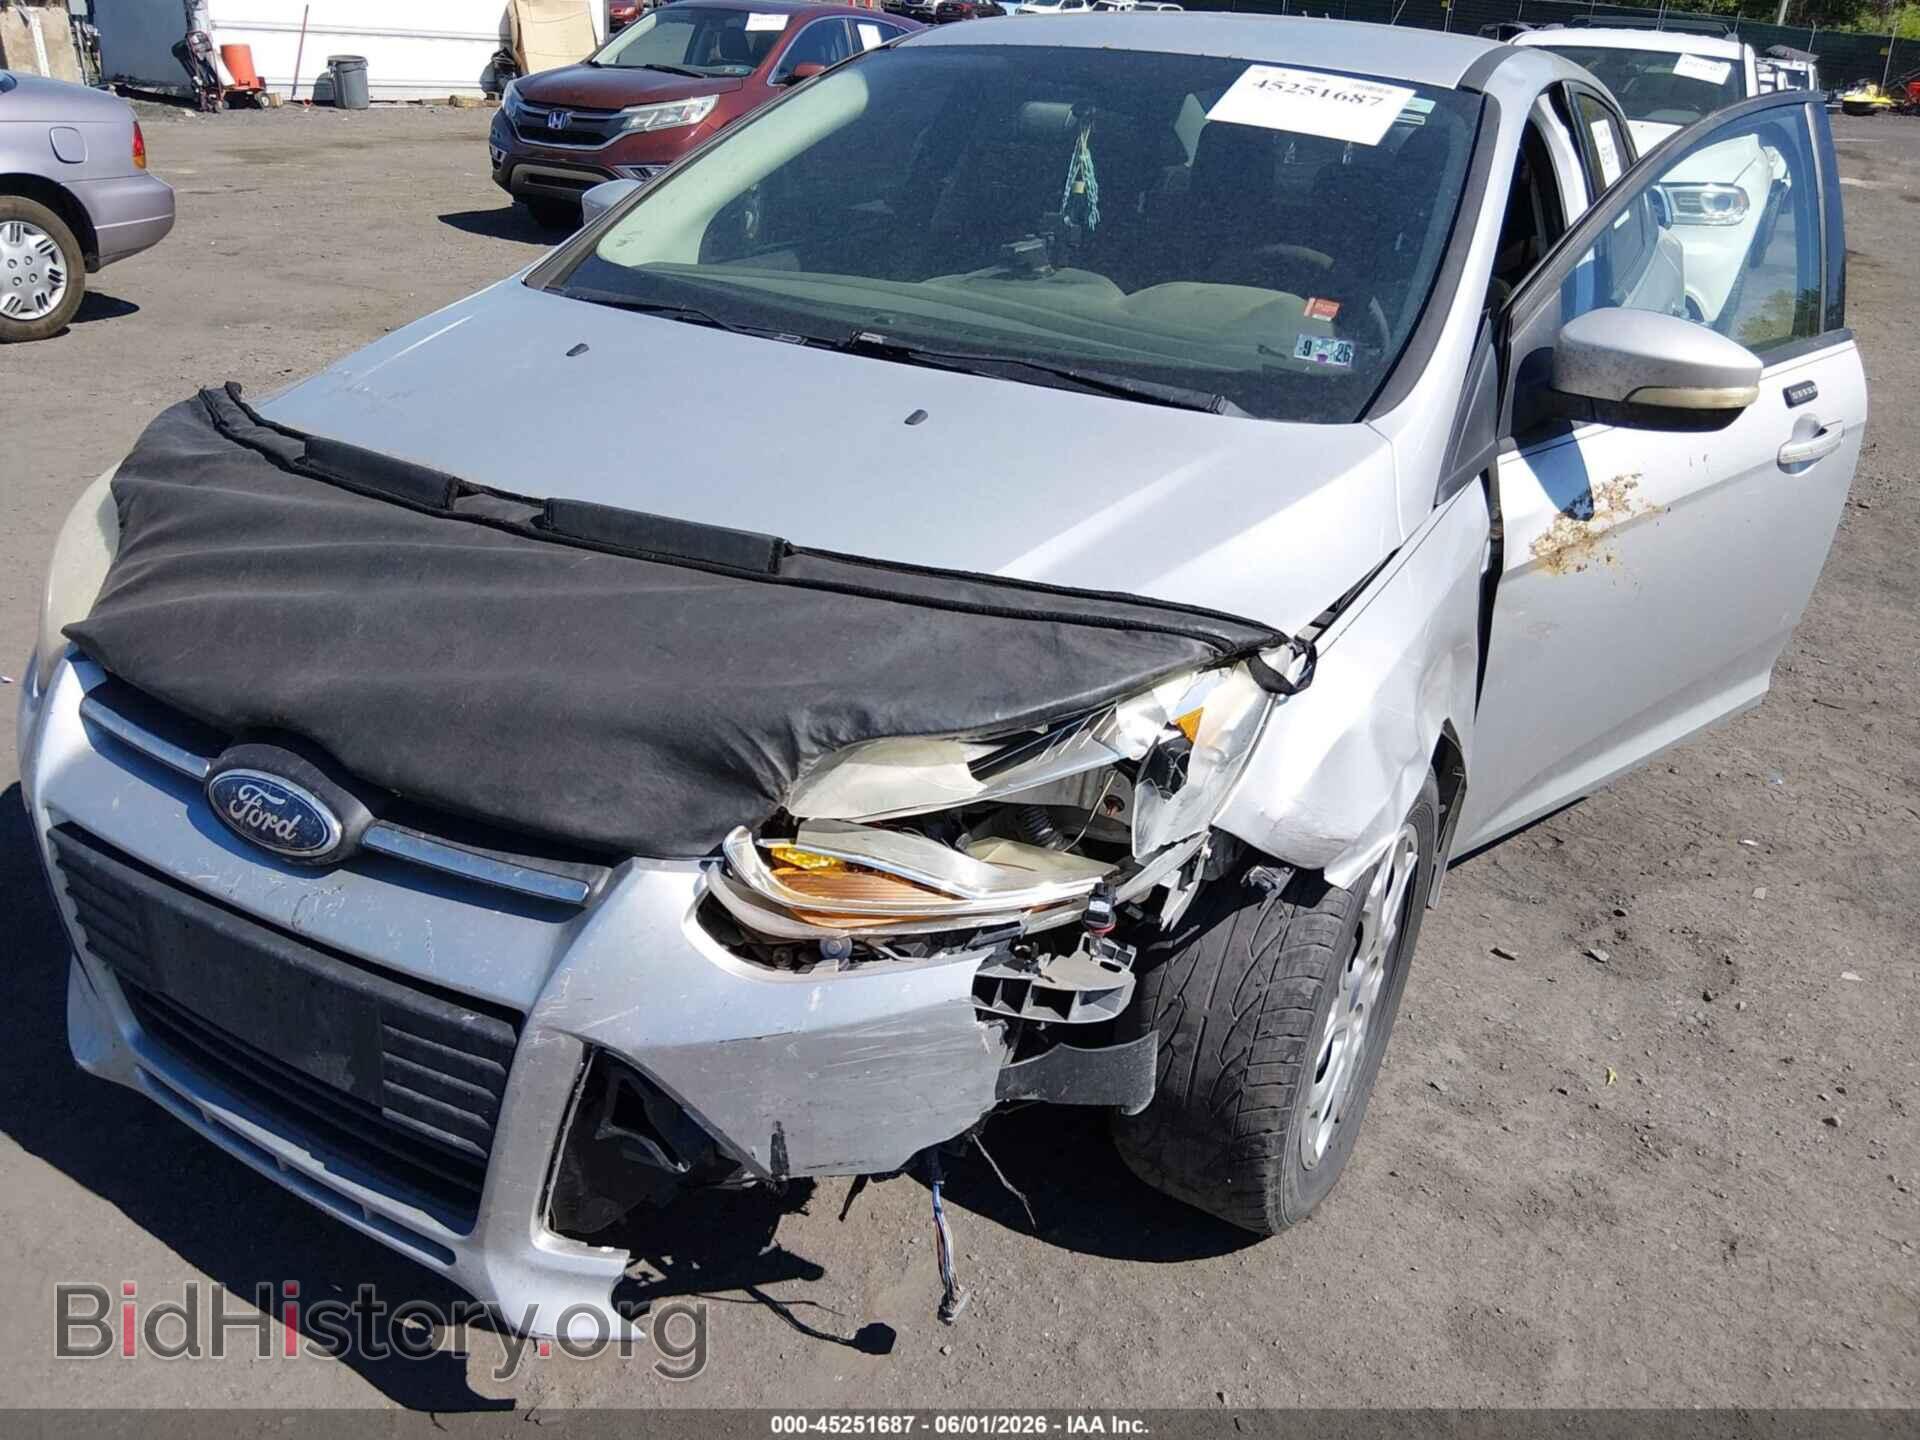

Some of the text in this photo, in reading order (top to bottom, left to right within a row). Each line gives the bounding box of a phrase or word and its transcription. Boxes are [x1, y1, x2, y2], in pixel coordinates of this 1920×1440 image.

[1253, 79, 1384, 107] 45251687
[1335, 342, 1352, 363] 26
[229, 784, 301, 841] Ford
